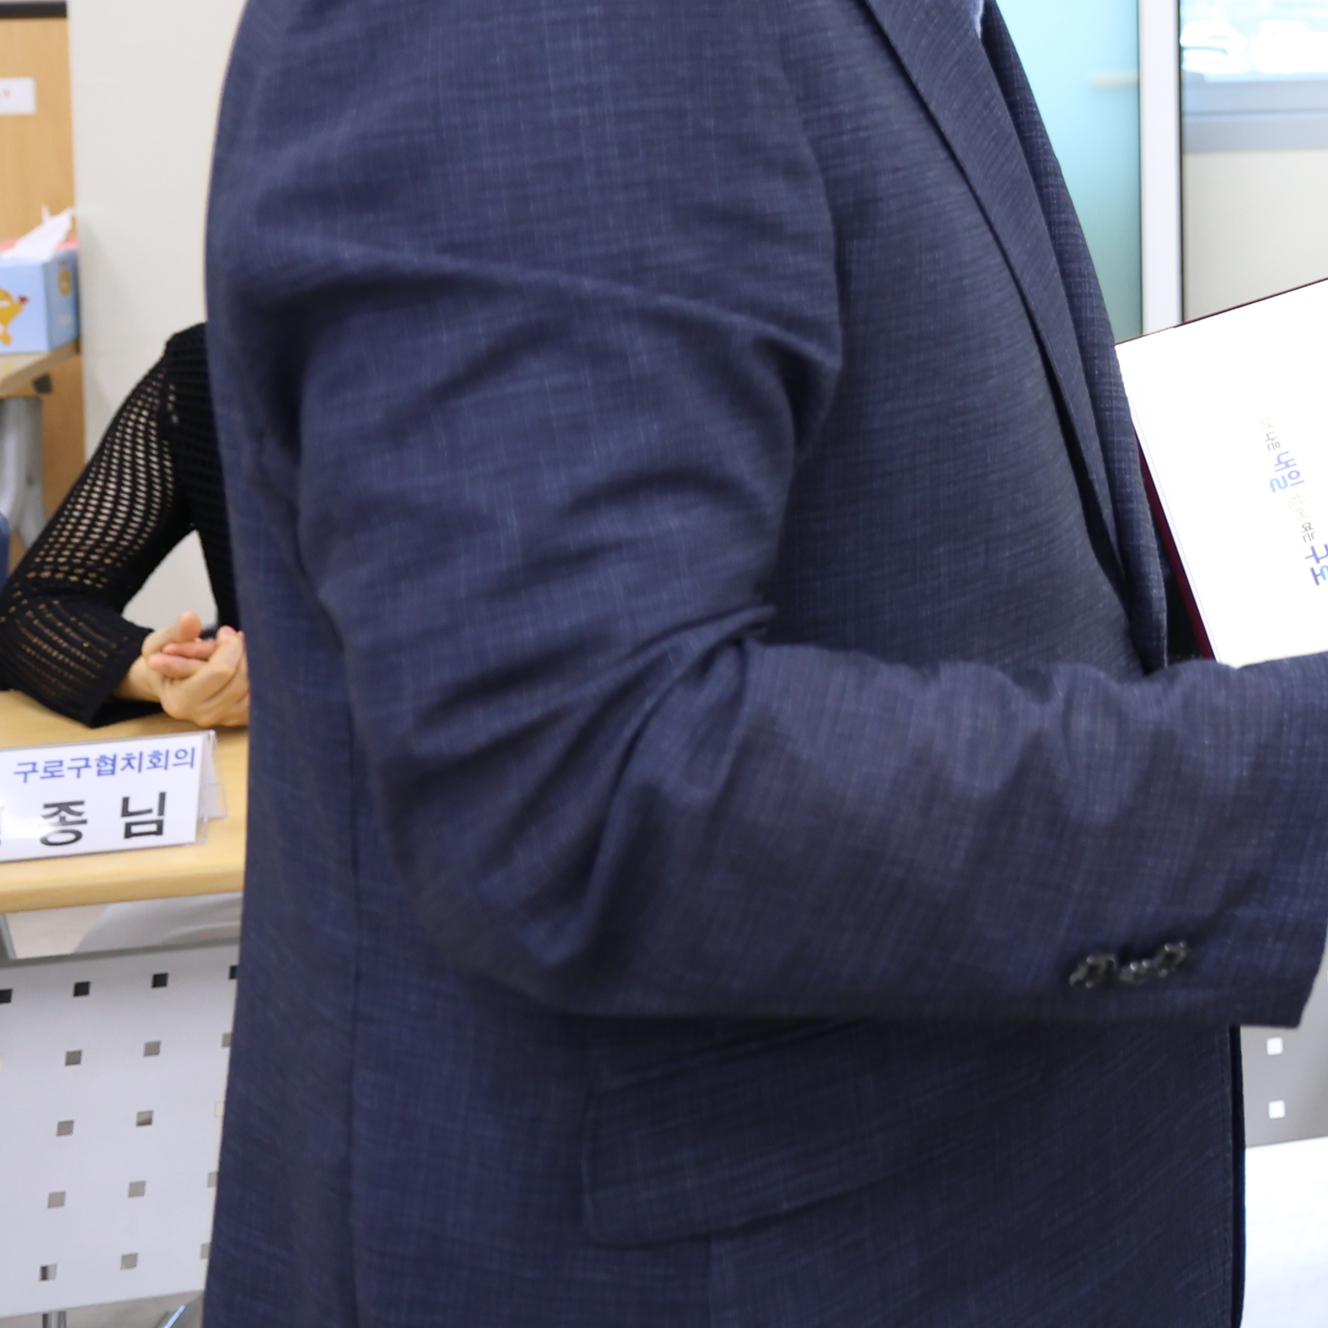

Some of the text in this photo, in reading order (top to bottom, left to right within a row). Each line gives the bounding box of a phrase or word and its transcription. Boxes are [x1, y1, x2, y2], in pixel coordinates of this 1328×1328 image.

[1265, 431, 1281, 451] 나은
[1269, 451, 1305, 493] 내일
[1301, 522, 1316, 543] 여는
[13, 747, 196, 784] 구로구협치회의
[0, 791, 167, 847] 종님
